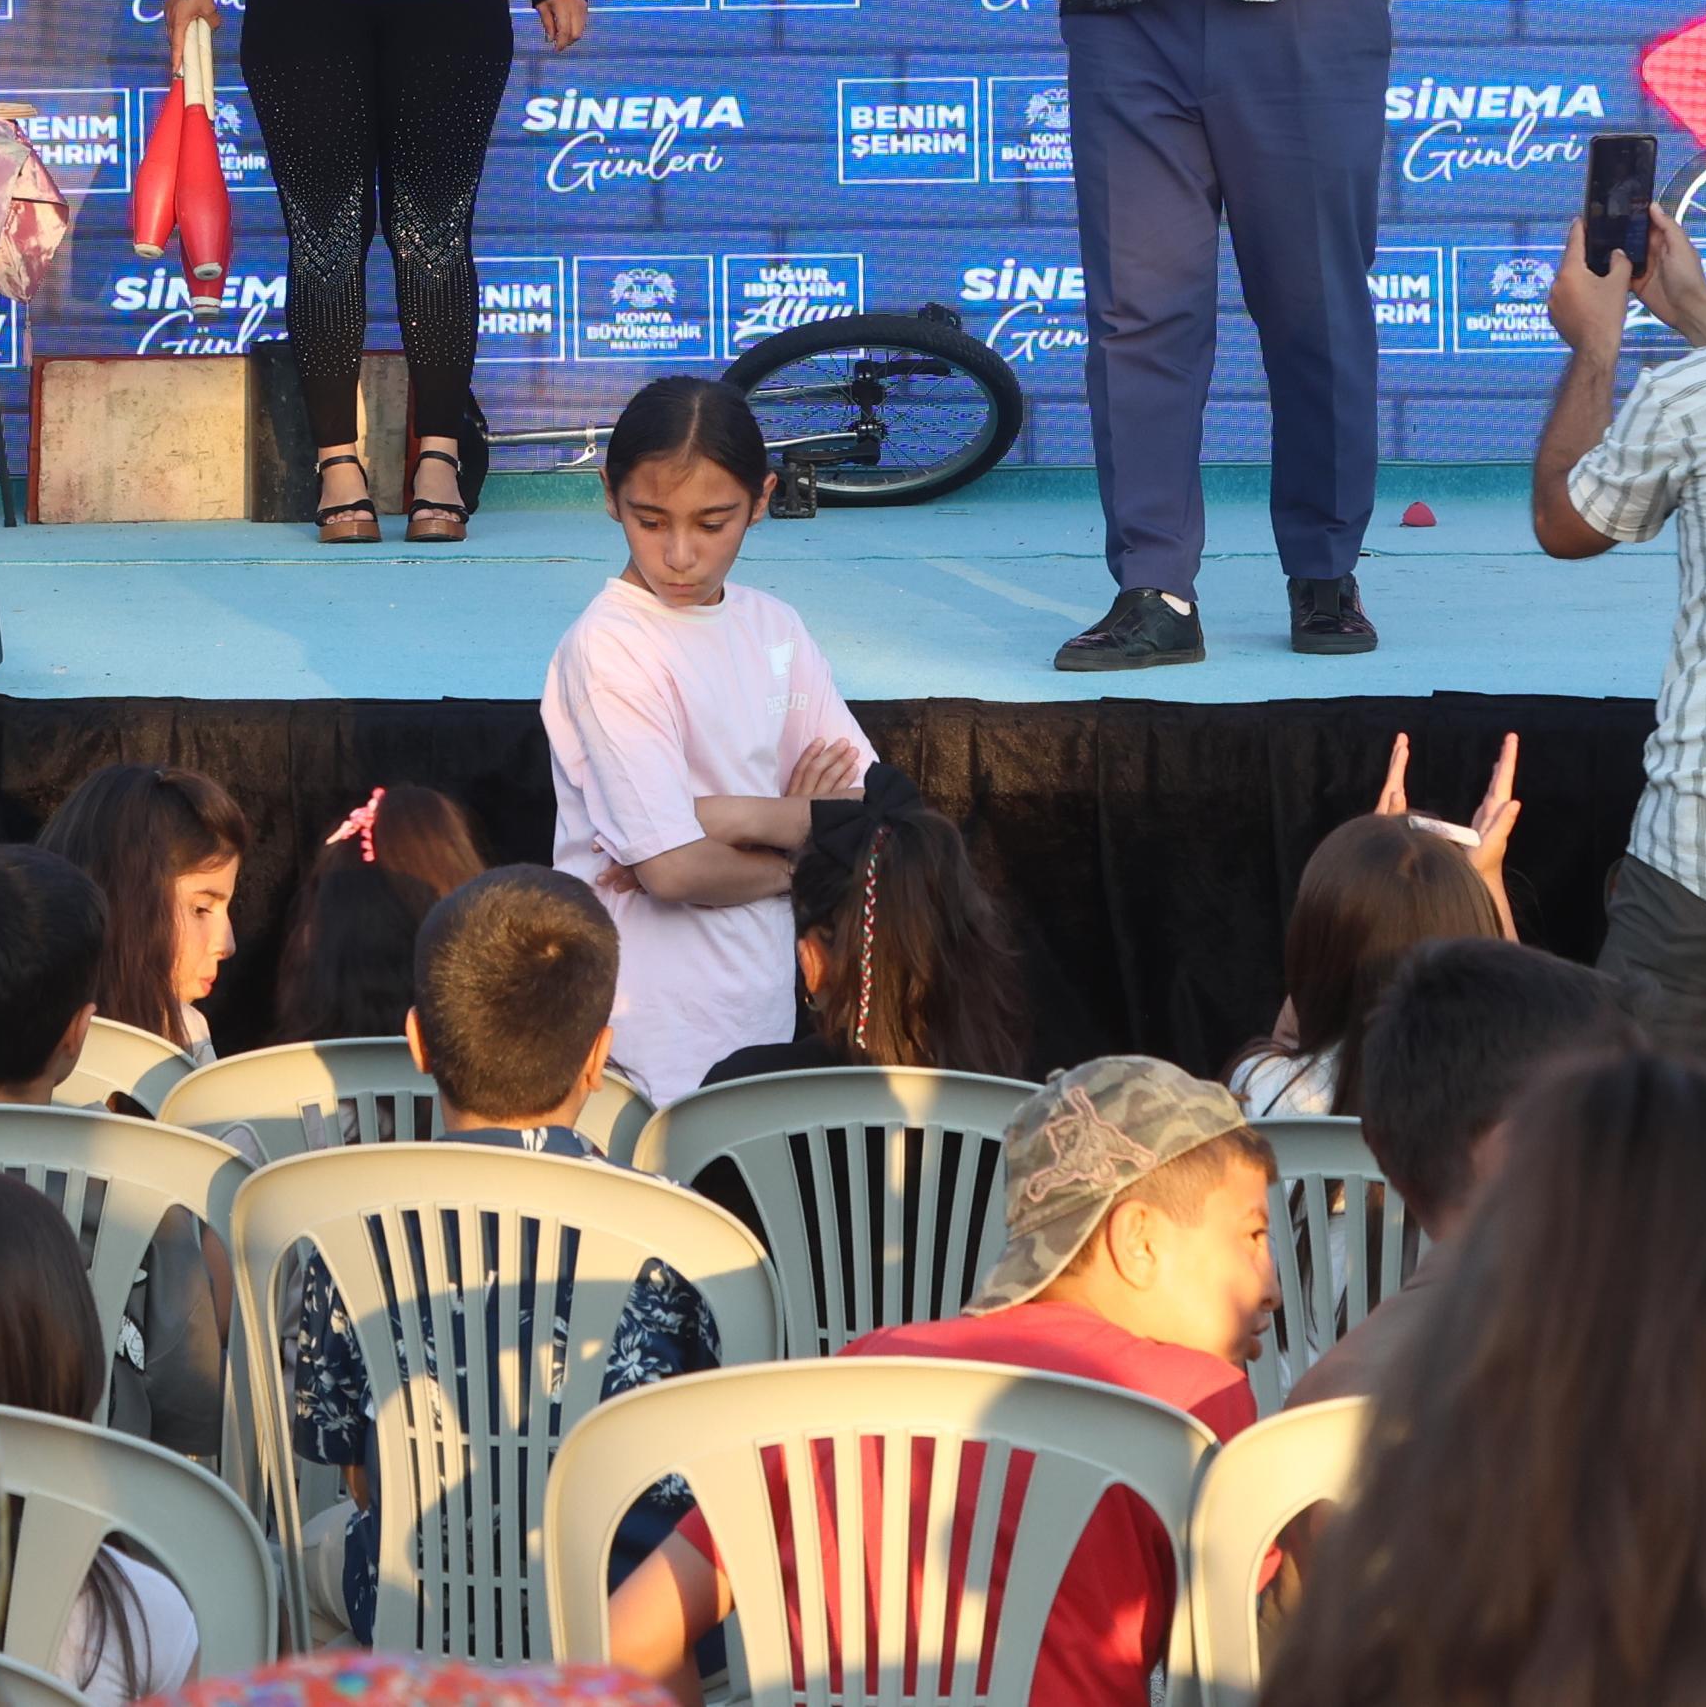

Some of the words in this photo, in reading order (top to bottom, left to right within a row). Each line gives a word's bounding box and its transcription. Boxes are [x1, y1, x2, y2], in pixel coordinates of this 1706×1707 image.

[523, 89, 744, 131] SİNEMA
[1384, 77, 1605, 119] SİNEMA
[850, 104, 965, 129] BENİM
[851, 132, 967, 158] ŞEHRİM
[1030, 133, 1071, 145] KON
[1402, 111, 1584, 183] Günleri
[33, 144, 118, 165] HRİM
[546, 123, 723, 193] Günleri
[759, 263, 829, 282] UĞUR
[960, 258, 1087, 301] SİNE
[111, 268, 287, 311] SİNEM
[479, 284, 551, 308] NİM
[1366, 274, 1430, 298] NİM
[478, 312, 552, 334] HRİM
[615, 311, 673, 324] KONYA
[1375, 302, 1431, 324] RİM
[587, 321, 701, 341] BÜYÜKŞEHİR
